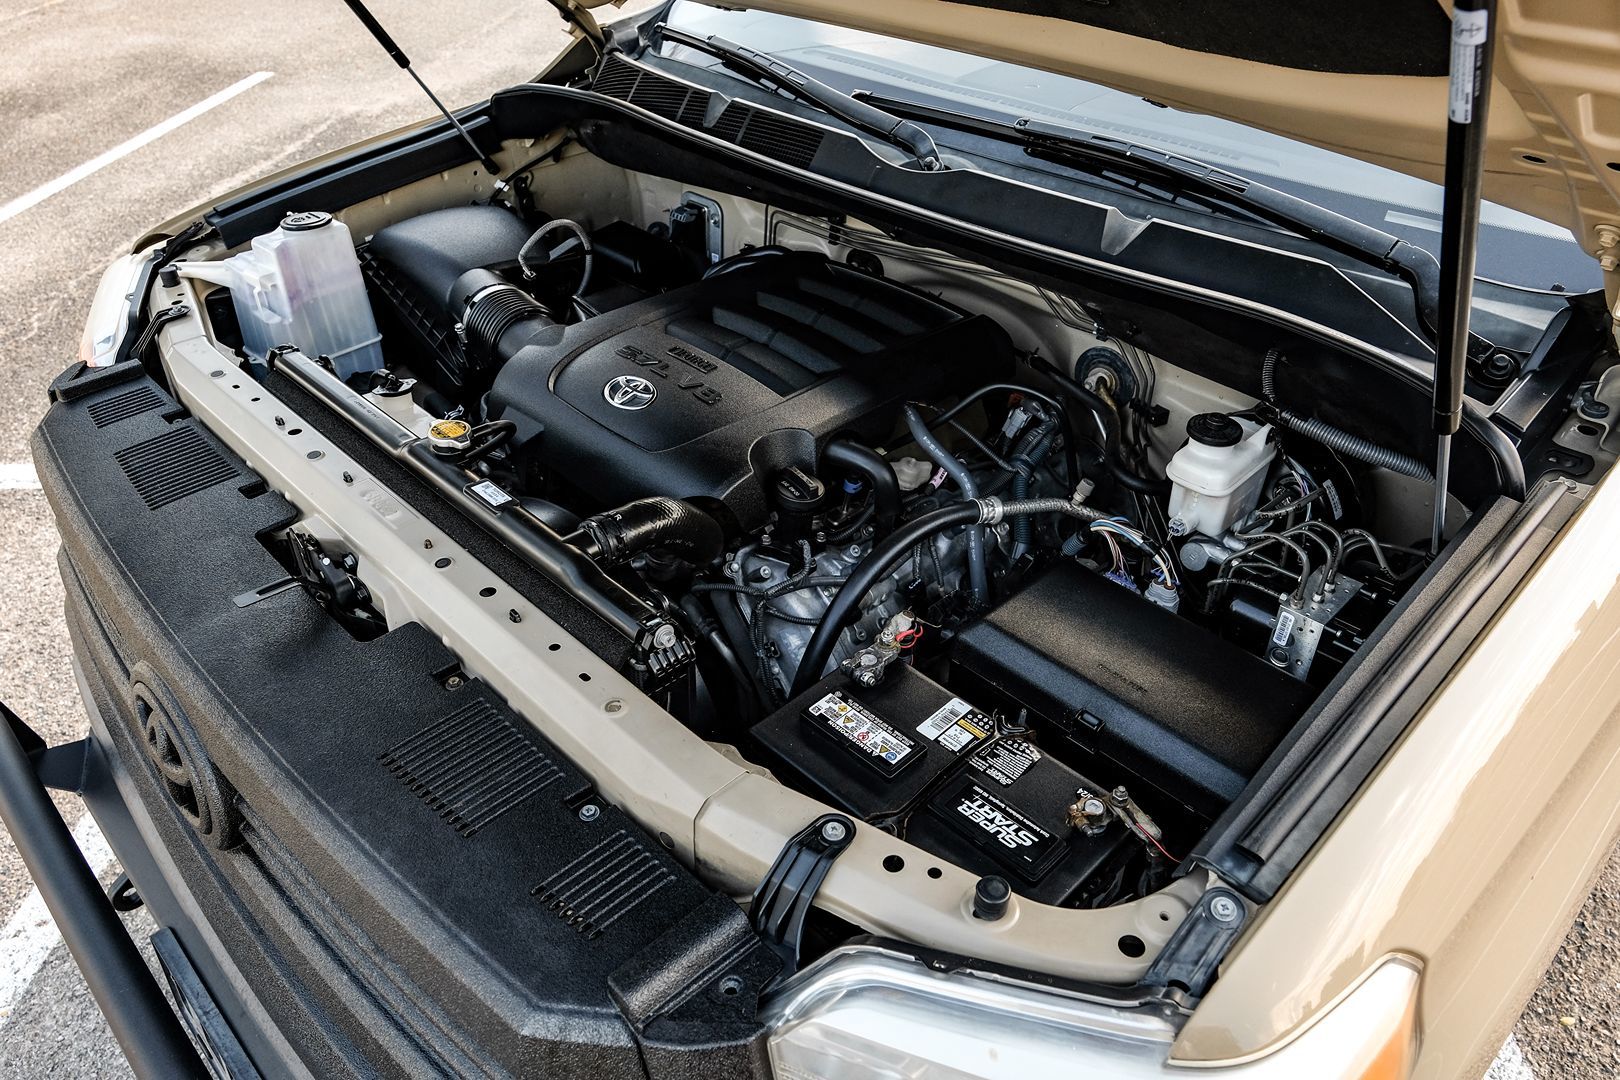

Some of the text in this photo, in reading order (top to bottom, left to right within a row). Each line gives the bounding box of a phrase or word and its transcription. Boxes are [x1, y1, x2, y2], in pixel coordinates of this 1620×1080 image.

[678, 374, 723, 404] V8
[957, 803, 1017, 849] SUPER
[964, 800, 1039, 847] START
